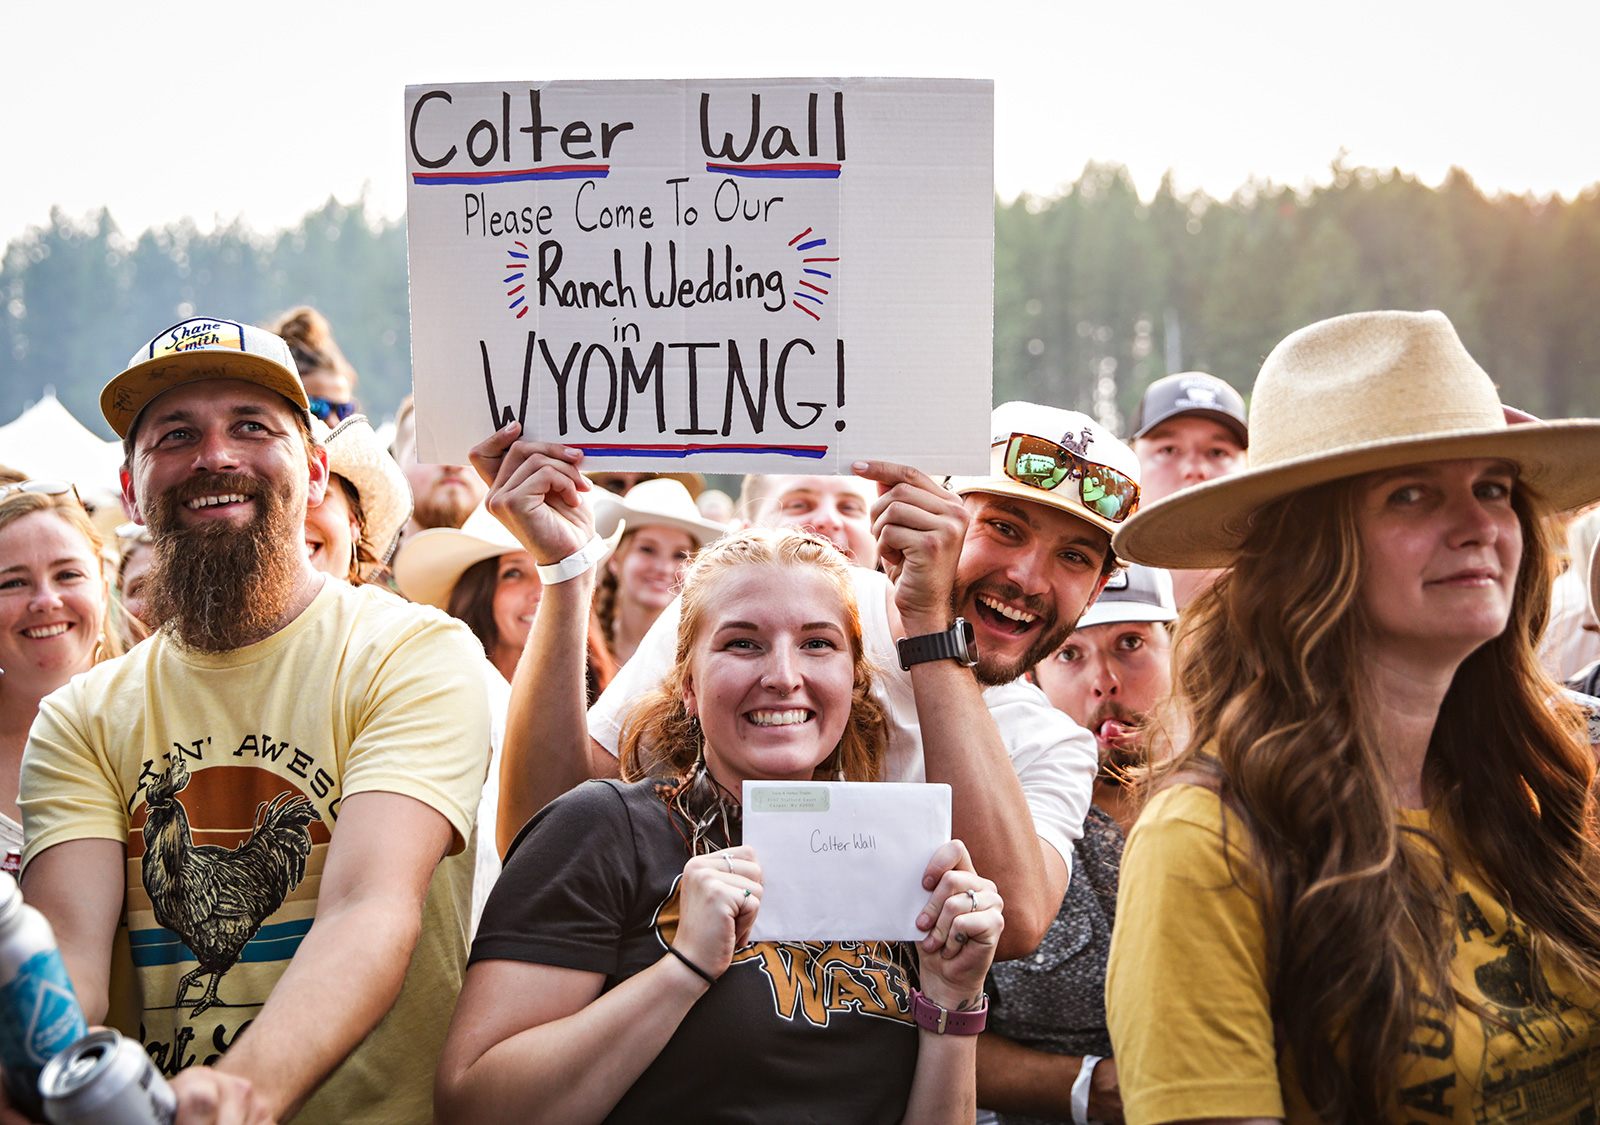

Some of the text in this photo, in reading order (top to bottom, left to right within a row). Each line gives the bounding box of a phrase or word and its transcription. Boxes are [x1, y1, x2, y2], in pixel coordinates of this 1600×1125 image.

[410, 89, 846, 168] Colter Wall
[465, 177, 784, 237] Please Come To Our
[538, 240, 787, 313] Ranch Wedding
[165, 323, 221, 350] Shane
[613, 317, 640, 343] in
[480, 330, 846, 437] WYOMING!
[810, 828, 877, 853] Colter Wall
